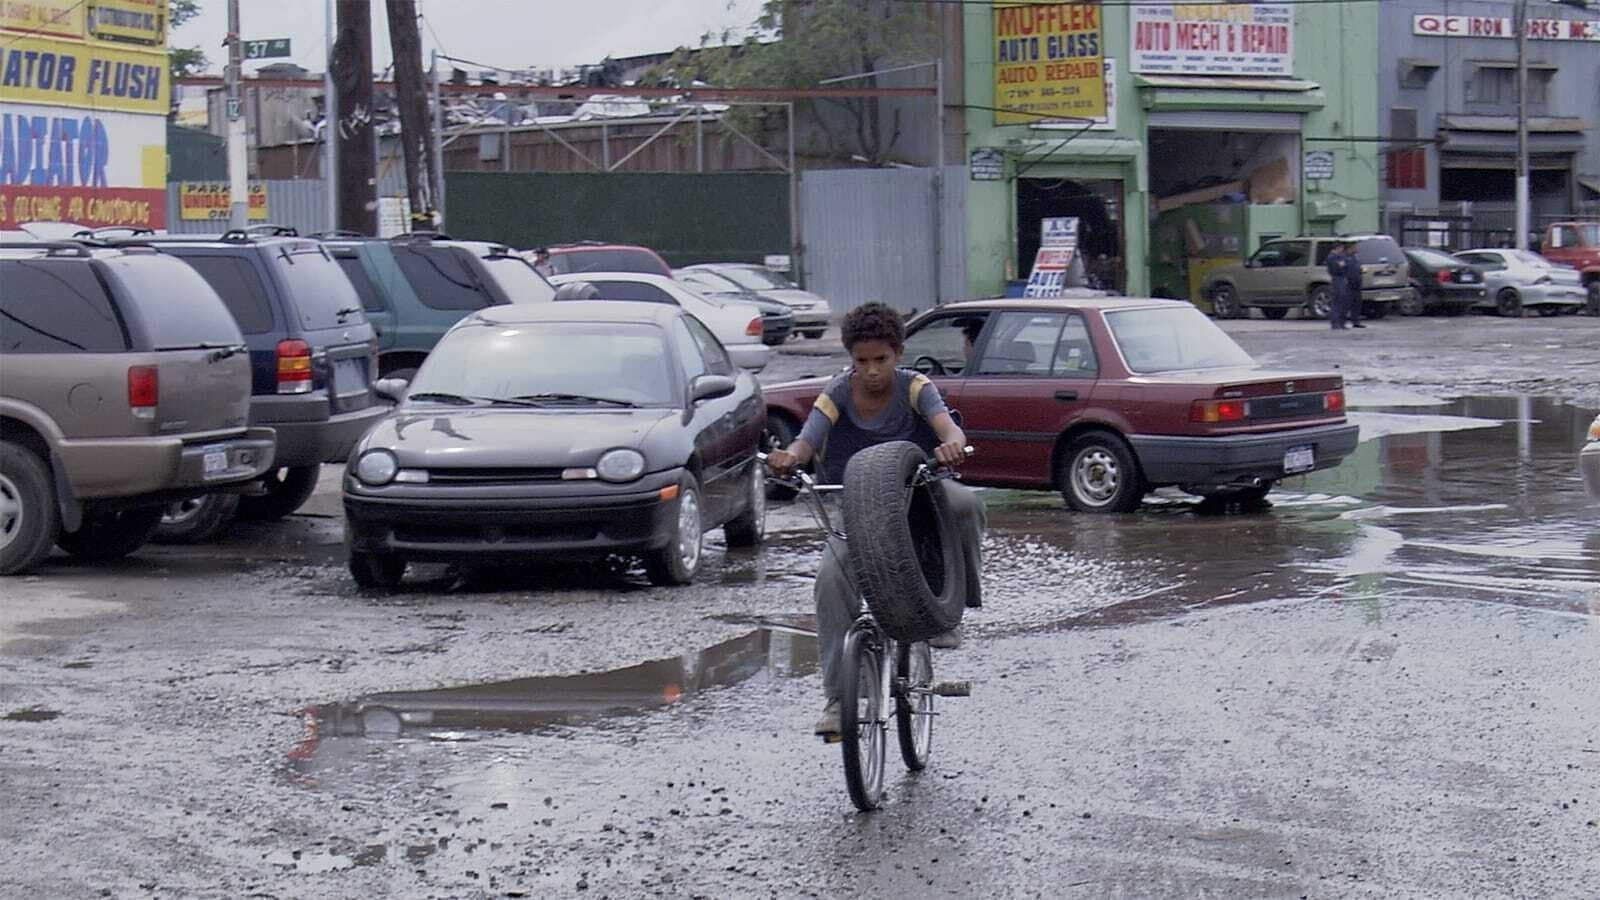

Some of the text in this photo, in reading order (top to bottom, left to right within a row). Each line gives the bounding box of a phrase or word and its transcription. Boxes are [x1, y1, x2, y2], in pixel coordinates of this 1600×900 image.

[998, 4, 1096, 36] MUFFLER
[1467, 18, 1503, 36] IRON
[247, 41, 269, 58] 37
[998, 32, 1099, 62] AUTO GLASS
[1135, 22, 1171, 51] AUTO
[1176, 22, 1220, 51] MECH
[1242, 25, 1288, 53] REPAIR
[0, 50, 161, 100] ATOR FLUSH
[998, 66, 1038, 84] AUTO
[1045, 62, 1099, 81] REPAIR
[0, 113, 109, 189] ADIATOR
[186, 184, 262, 194] PARKG
